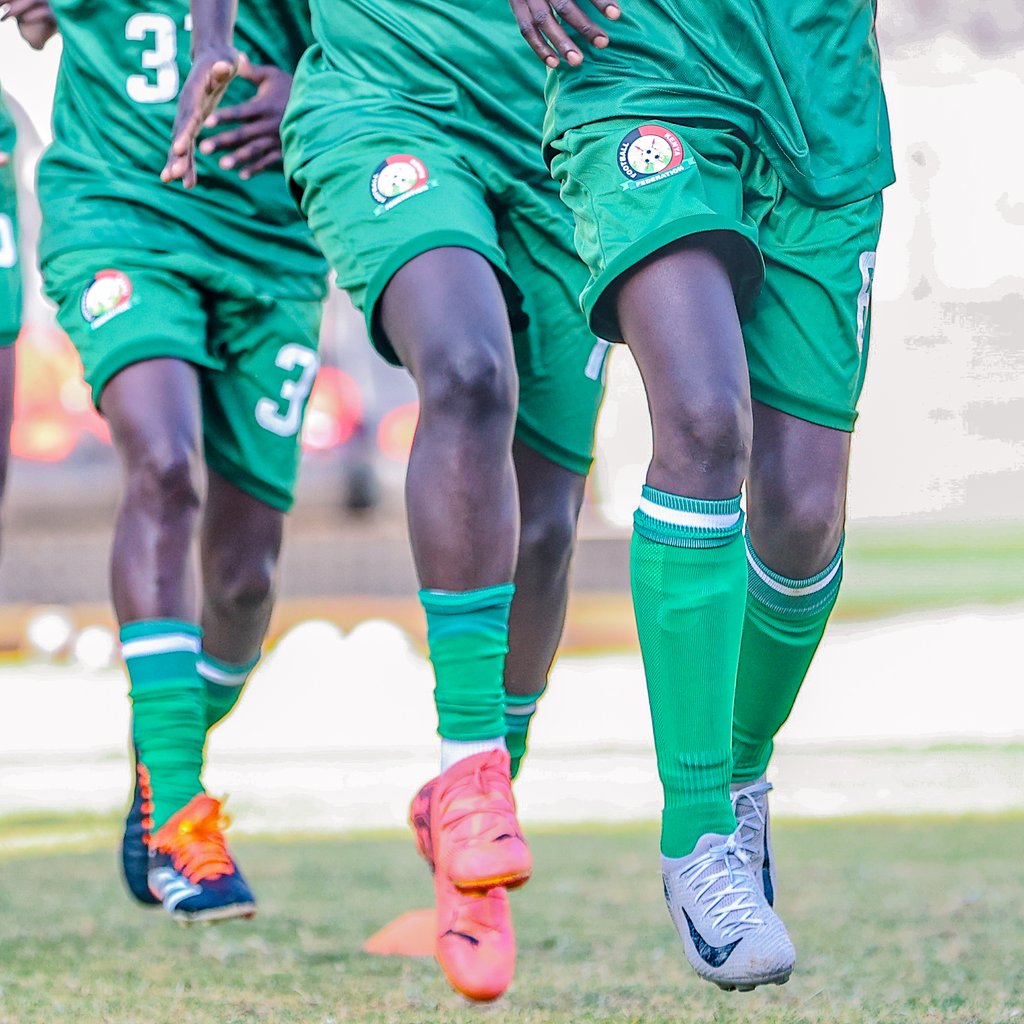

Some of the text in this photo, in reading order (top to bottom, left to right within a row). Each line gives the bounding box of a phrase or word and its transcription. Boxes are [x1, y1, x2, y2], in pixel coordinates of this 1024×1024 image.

[125, 12, 193, 104] 3
[663, 132, 682, 156] KENYA
[619, 142, 638, 179] FOOTBALL
[635, 164, 685, 187] FEDERATION
